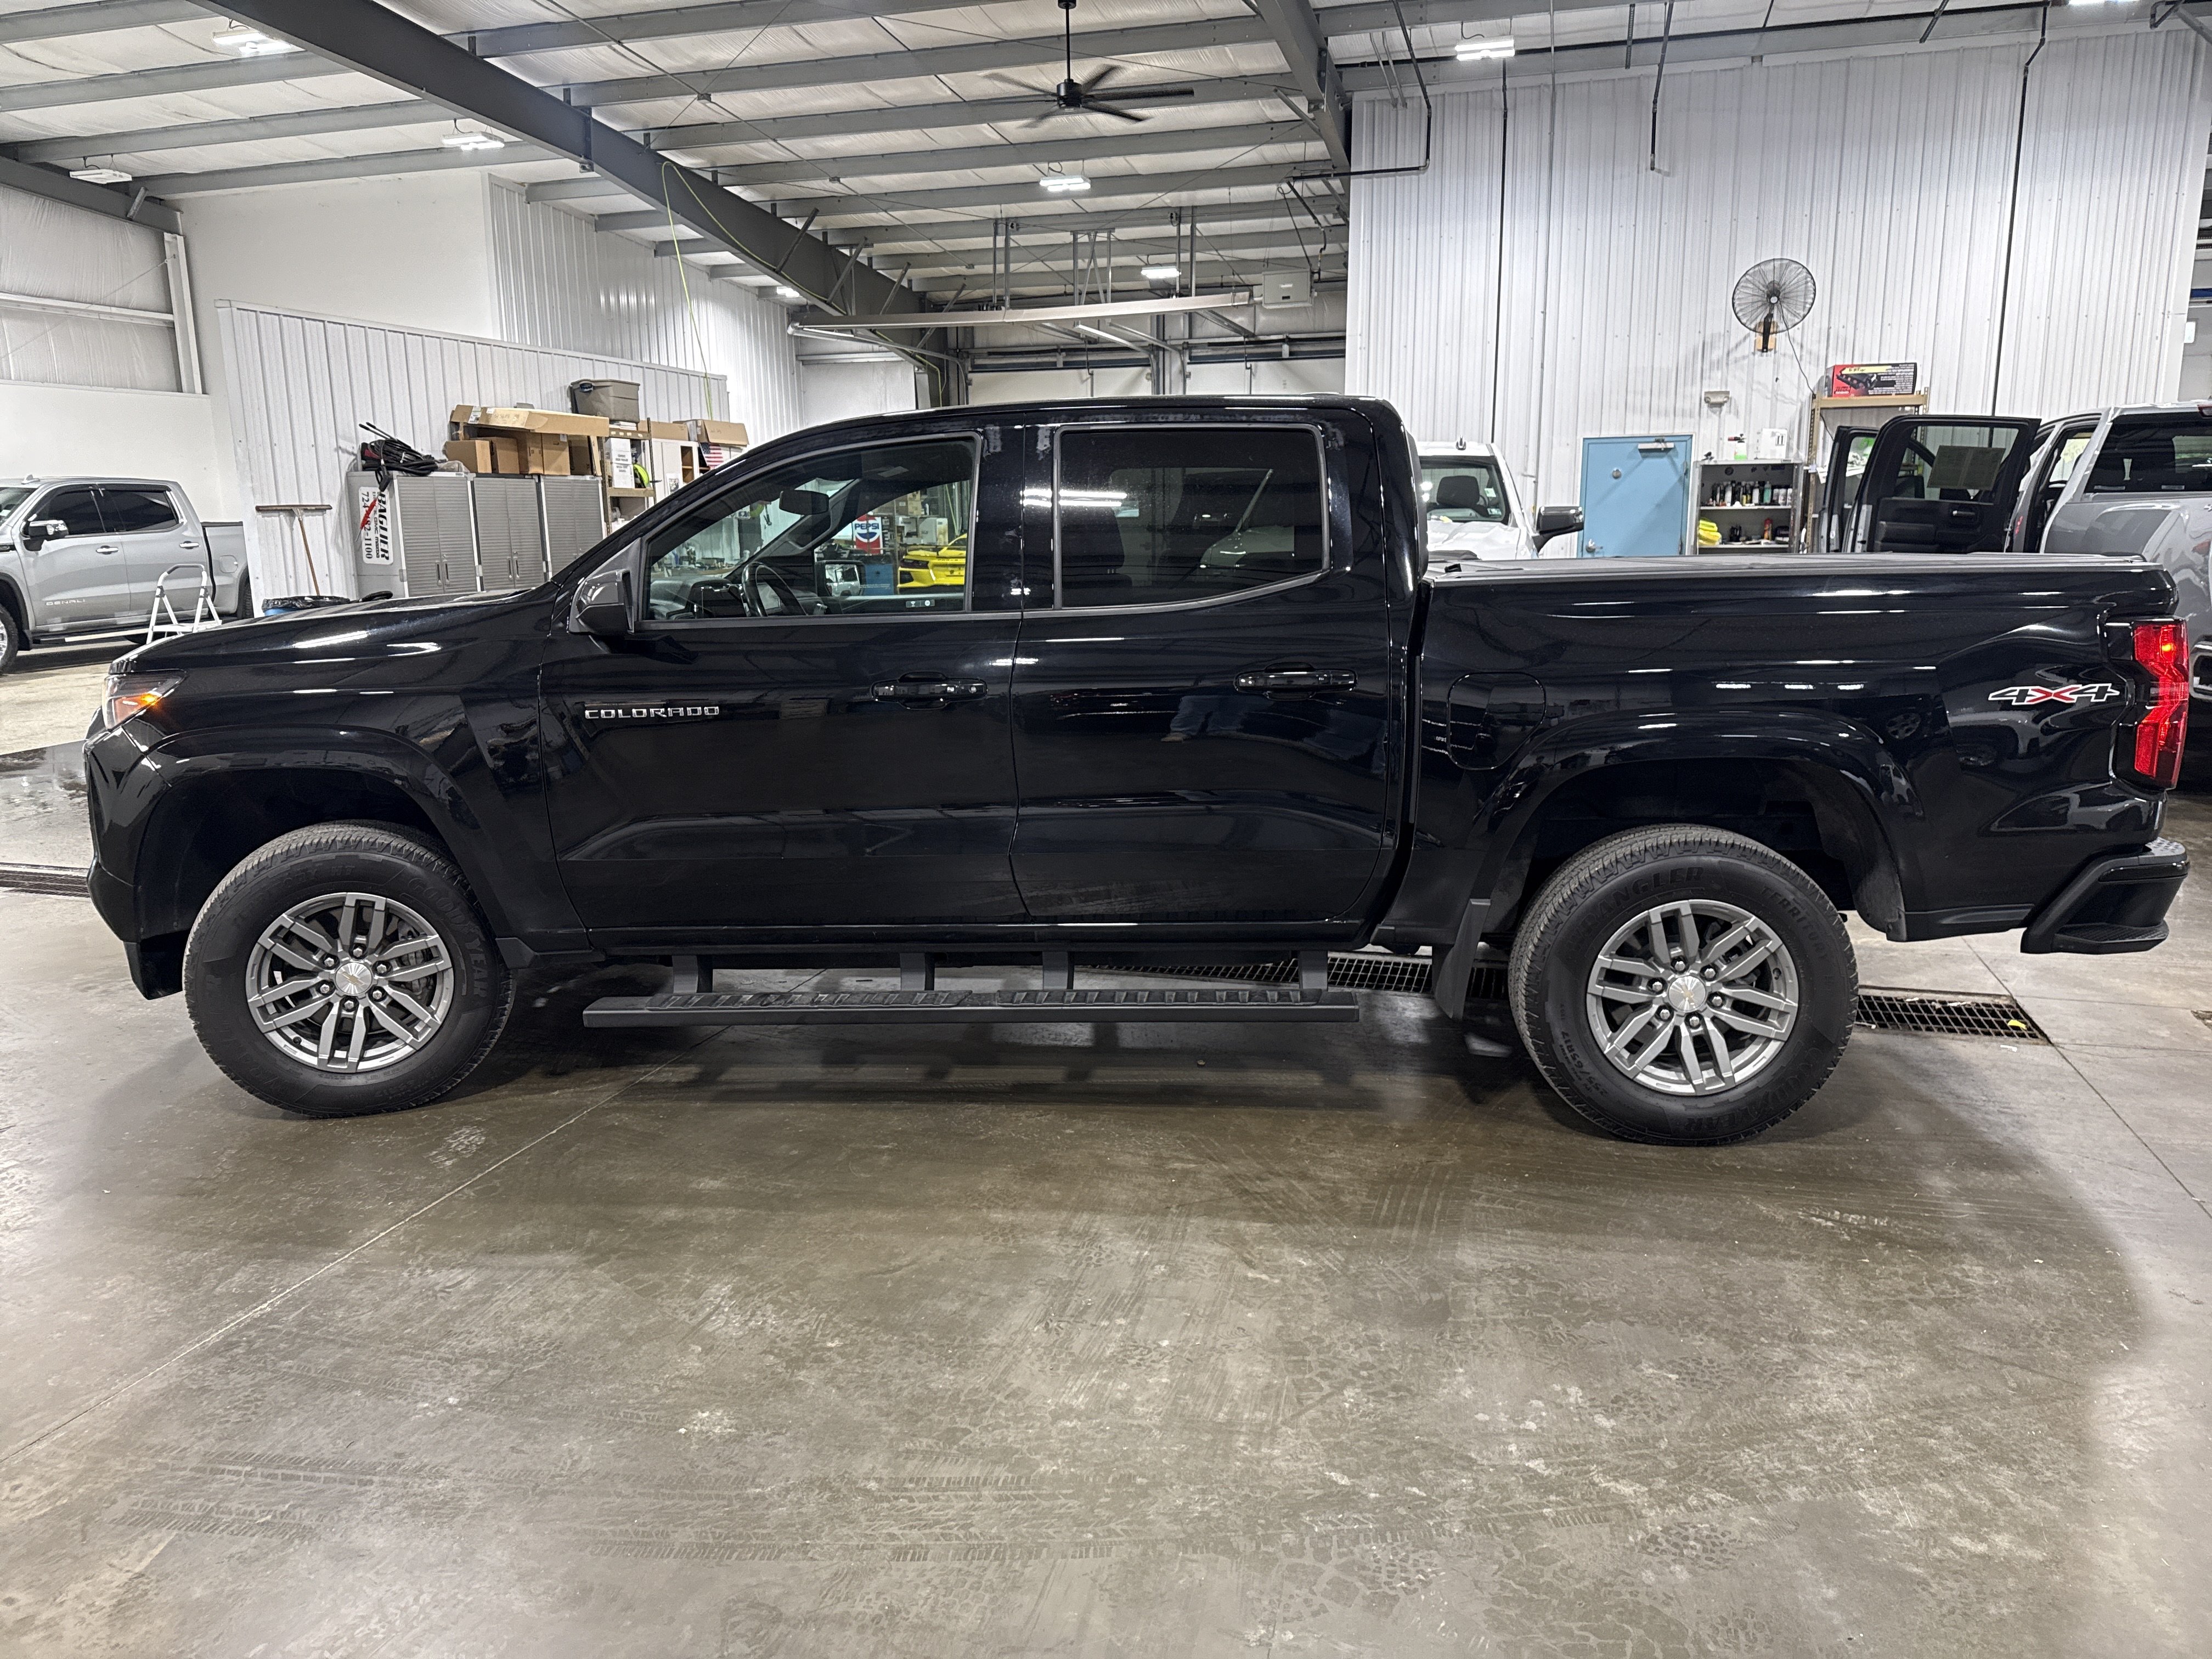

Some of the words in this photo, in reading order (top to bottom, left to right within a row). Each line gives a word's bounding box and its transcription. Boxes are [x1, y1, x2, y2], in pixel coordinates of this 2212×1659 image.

[362, 492, 373, 559] 724-82-1100
[377, 491, 389, 560] BAGLIER
[585, 706, 719, 719] COLORADO
